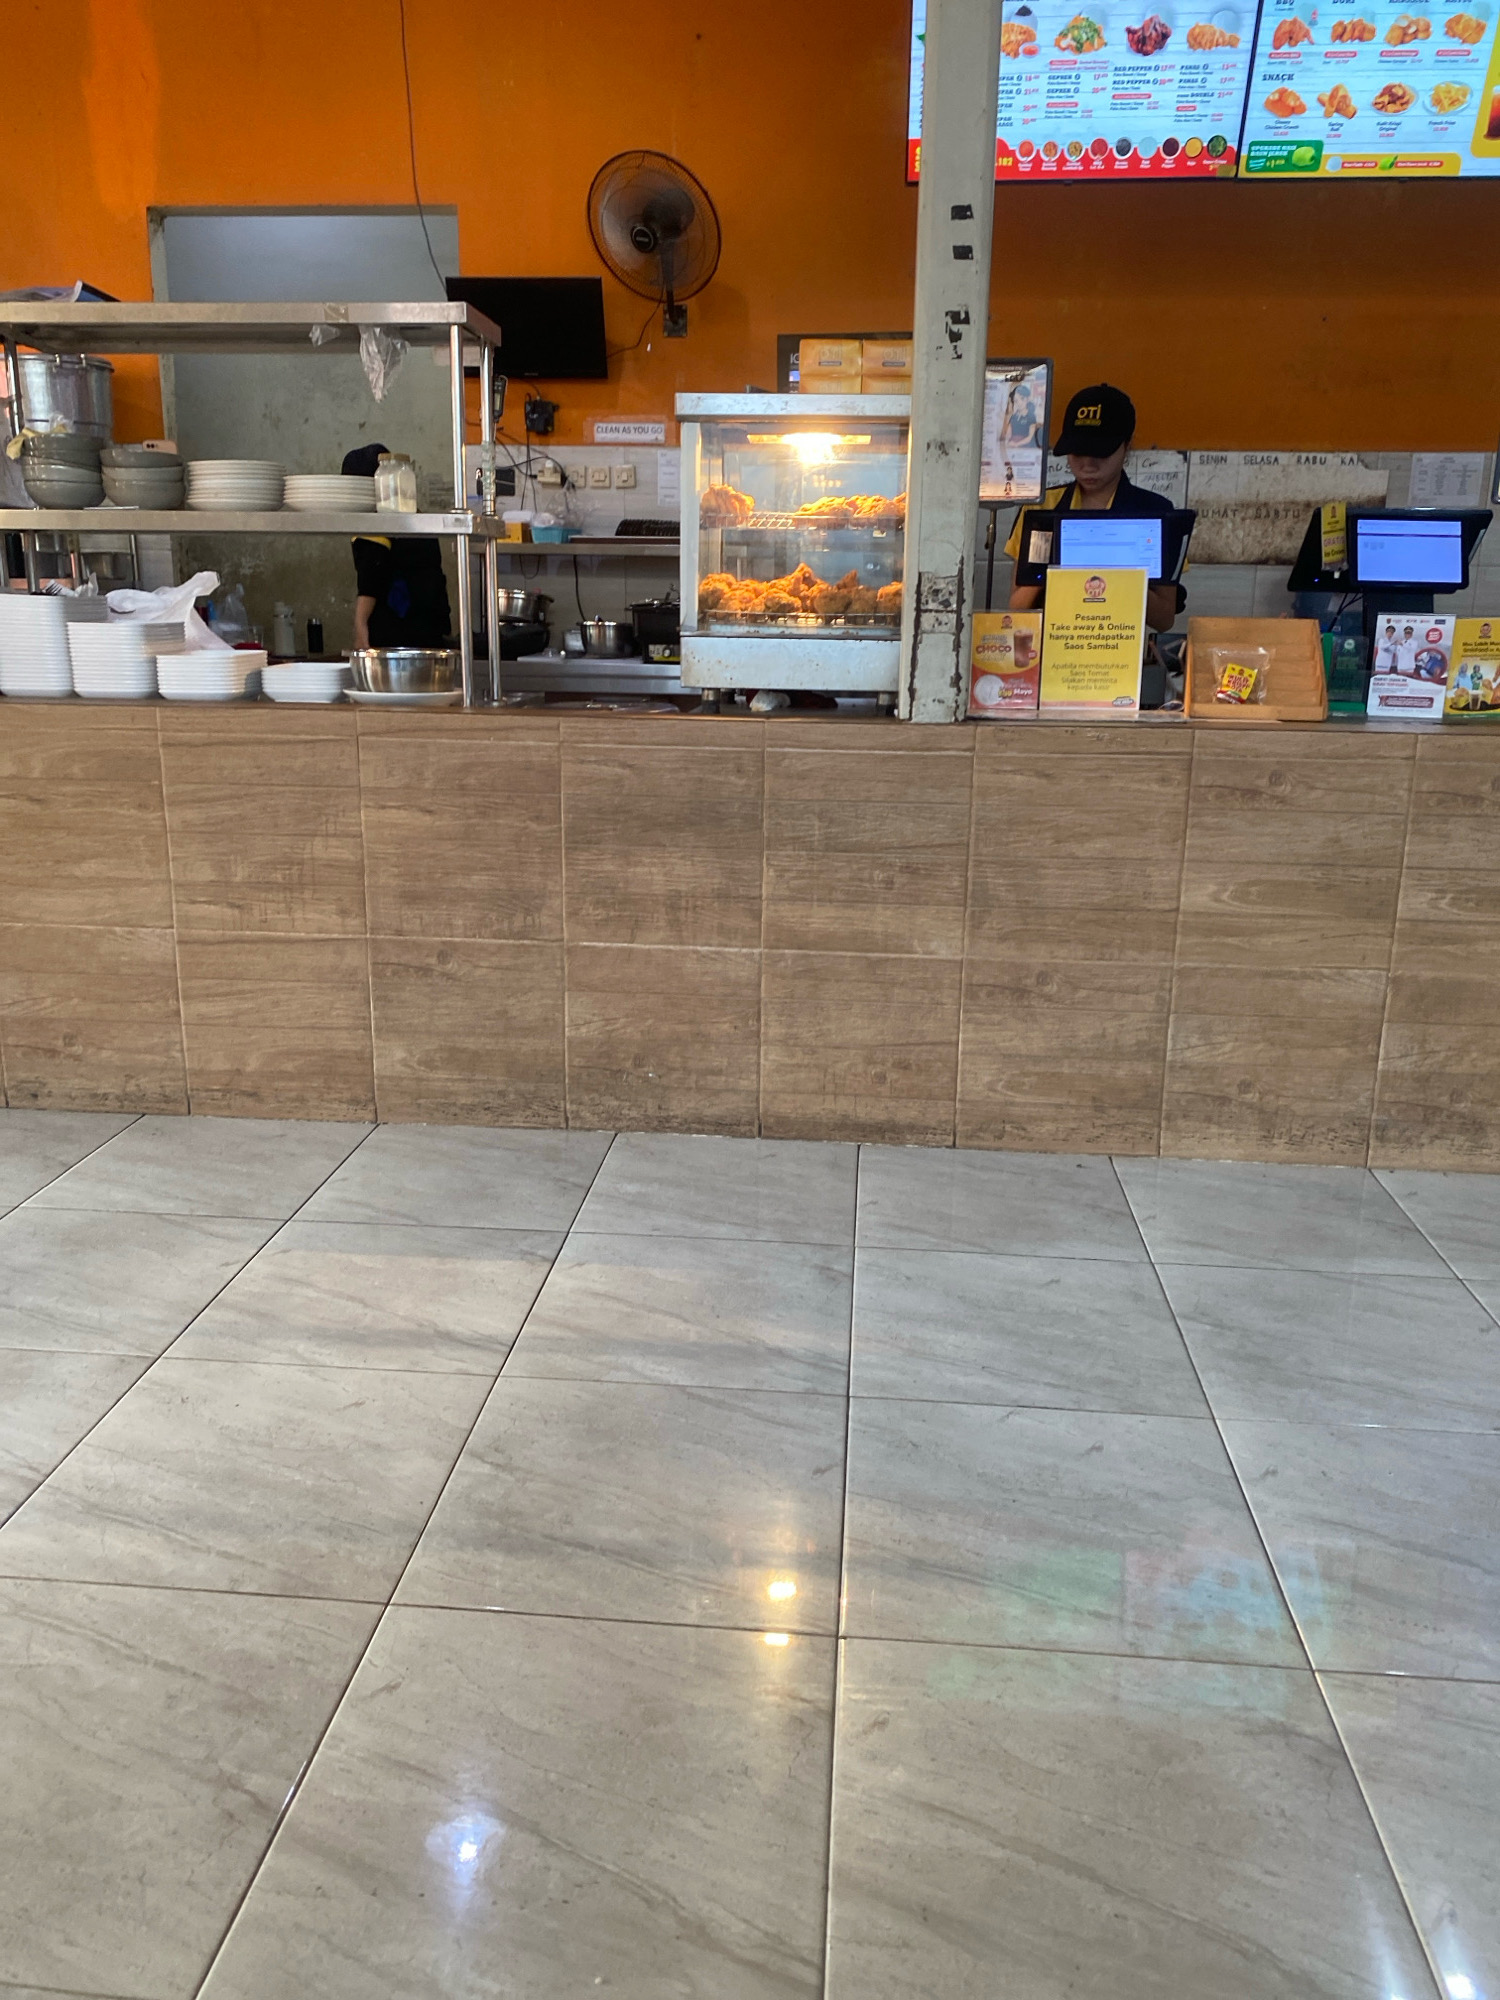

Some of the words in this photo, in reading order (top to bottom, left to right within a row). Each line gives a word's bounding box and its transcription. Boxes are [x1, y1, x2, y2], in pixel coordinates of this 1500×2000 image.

[1262, 74, 1295, 82] SNACK
[596, 426, 620, 434] CLEAN
[622, 426, 631, 434] AS
[633, 426, 649, 434] YOU
[651, 426, 663, 434] GO
[1199, 454, 1228, 465] SENIN
[1296, 455, 1327, 466] RABU
[1075, 613, 1111, 621] Pesanan
[1050, 623, 1070, 631] Take
[1073, 624, 1095, 632] away
[1098, 623, 1104, 631] &
[1107, 623, 1135, 631] Online
[1049, 633, 1074, 641] hanya
[1077, 633, 1135, 641] mendapatkan
[976, 645, 1012, 654] CHOCO
[1064, 642, 1084, 650] Saos
[1087, 642, 1119, 650] Sambal
